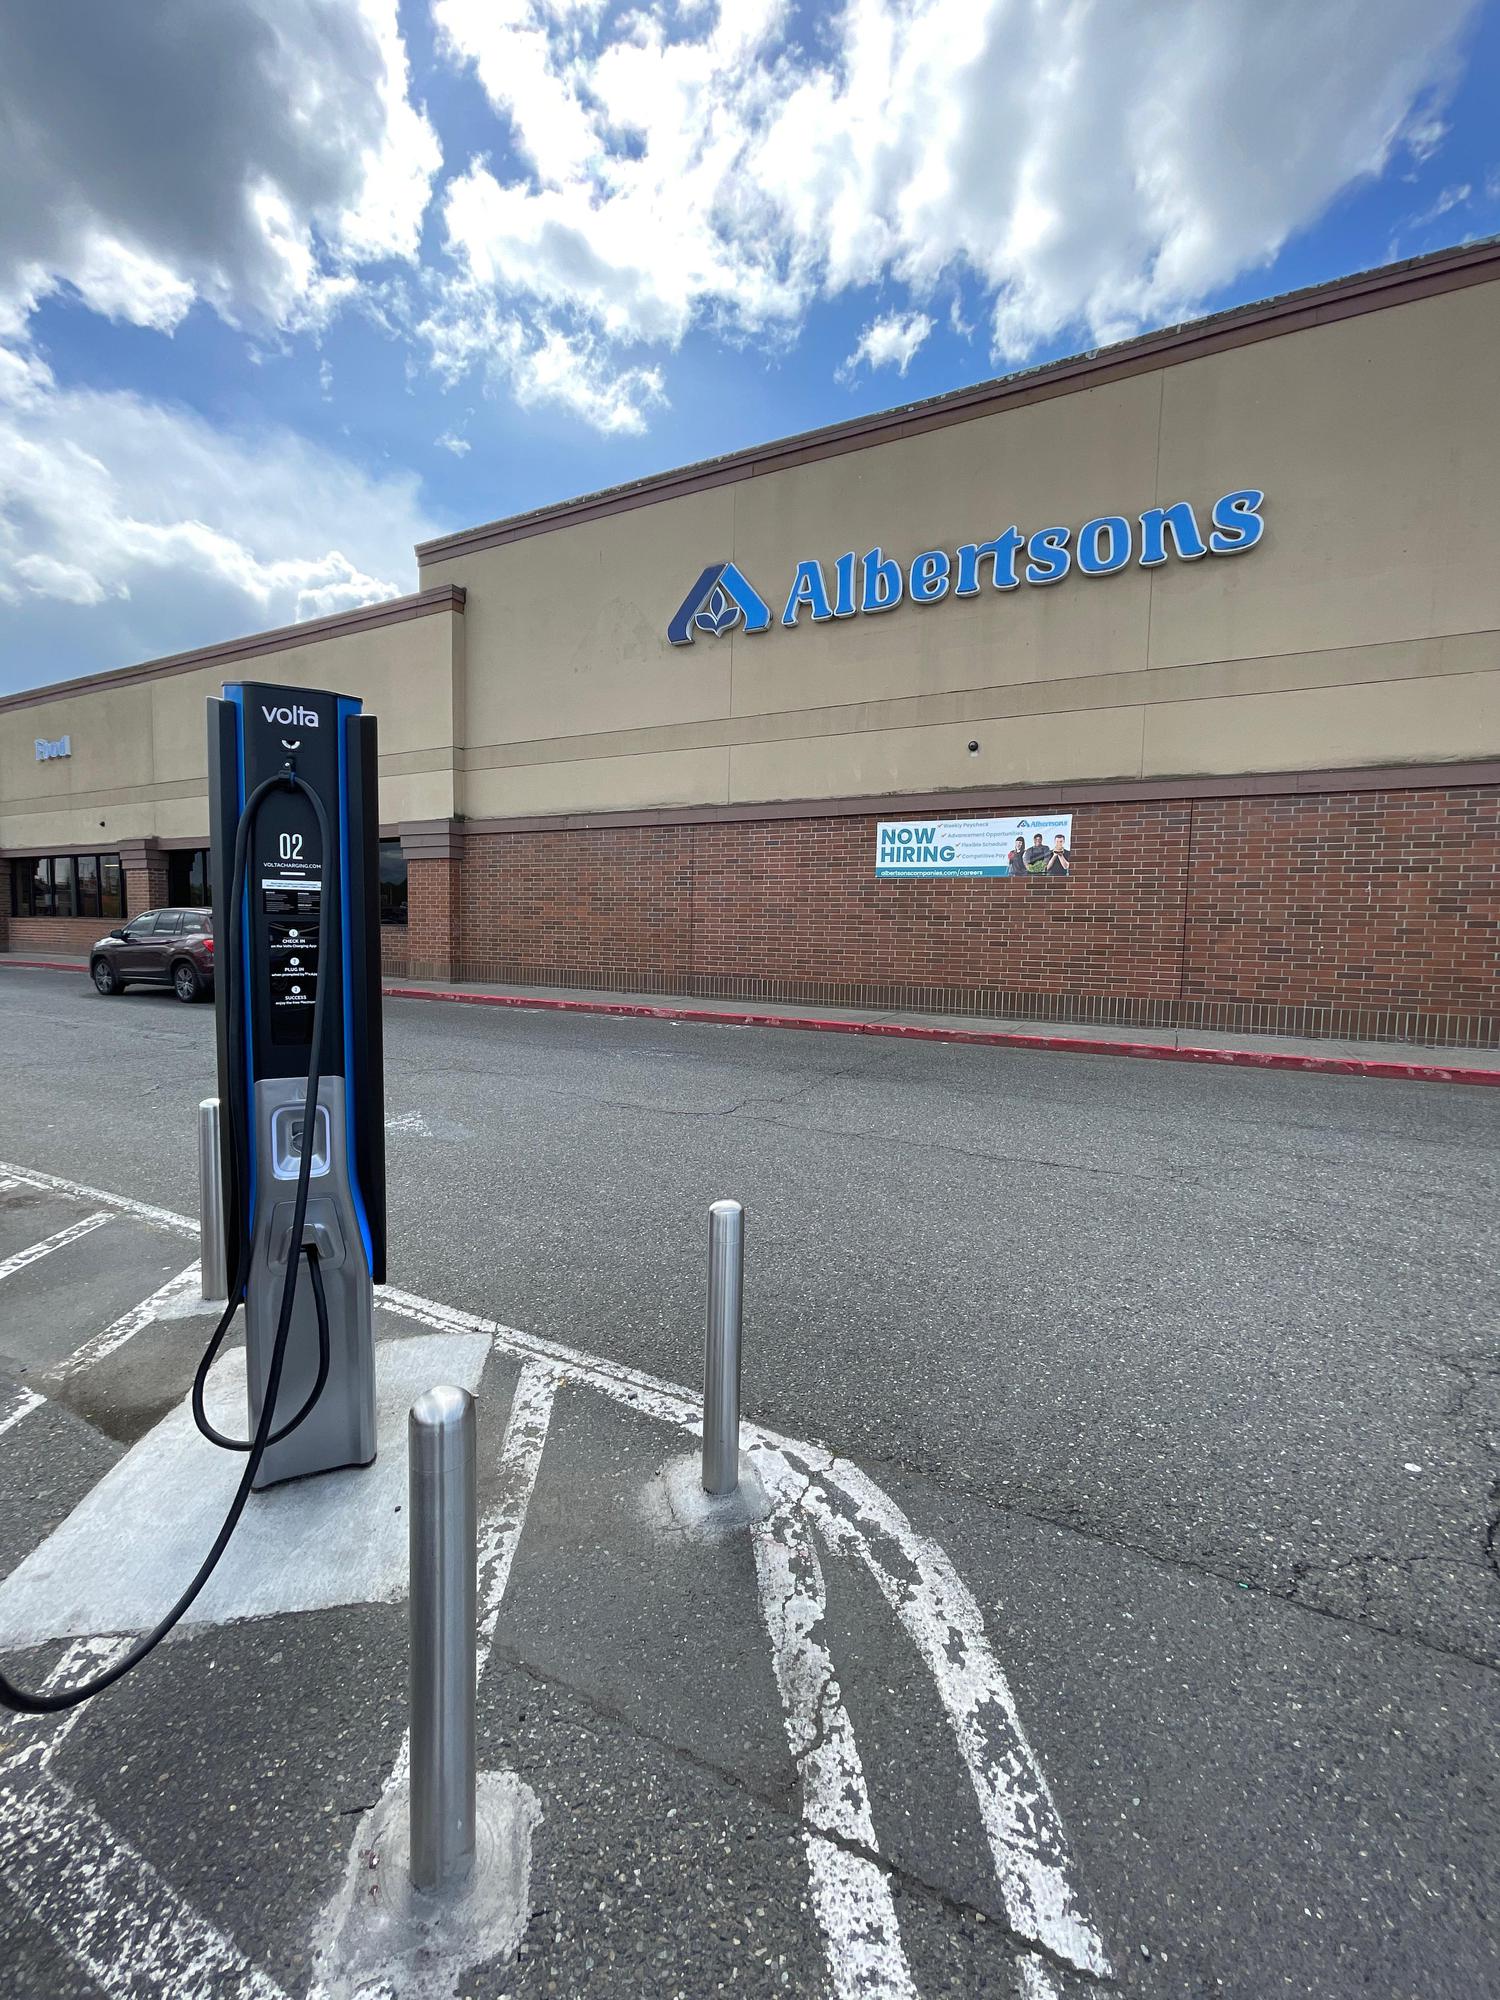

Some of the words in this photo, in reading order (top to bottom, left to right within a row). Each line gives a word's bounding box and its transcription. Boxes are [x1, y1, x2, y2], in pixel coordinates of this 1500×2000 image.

[781, 489, 1265, 626] Albertsons
[262, 705, 319, 727] volta
[962, 821, 989, 829] Paycheck
[1030, 820, 1068, 828] Albertsons
[881, 828, 936, 845] NOW
[986, 830, 1023, 838] Opportunities
[280, 833, 303, 859] 02
[880, 846, 955, 862] HIRING
[881, 869, 983, 878] albertsonscompanies.com/careers
